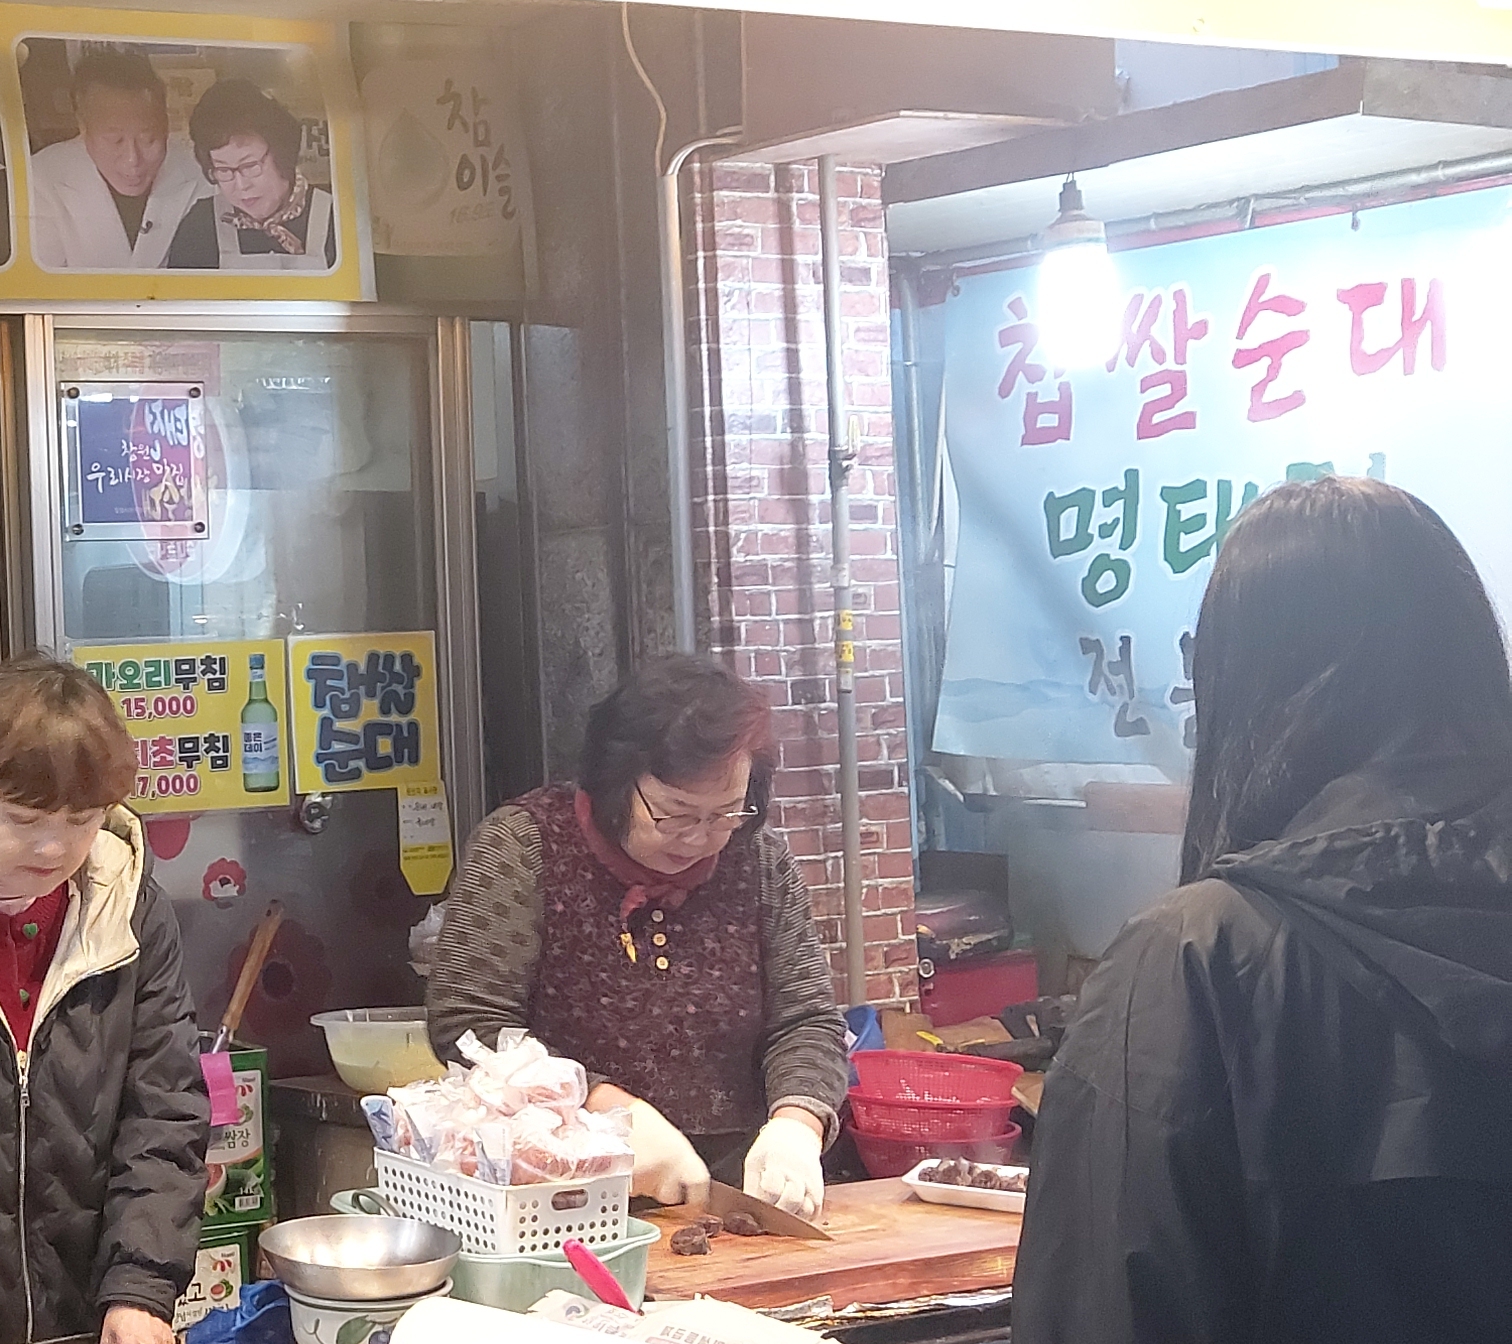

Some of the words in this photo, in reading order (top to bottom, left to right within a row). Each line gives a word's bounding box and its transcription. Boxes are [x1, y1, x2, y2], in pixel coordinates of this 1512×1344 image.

[121, 695, 197, 721] 15,000
[315, 715, 420, 784] 순대
[224, 1128, 250, 1149] 쌈장
